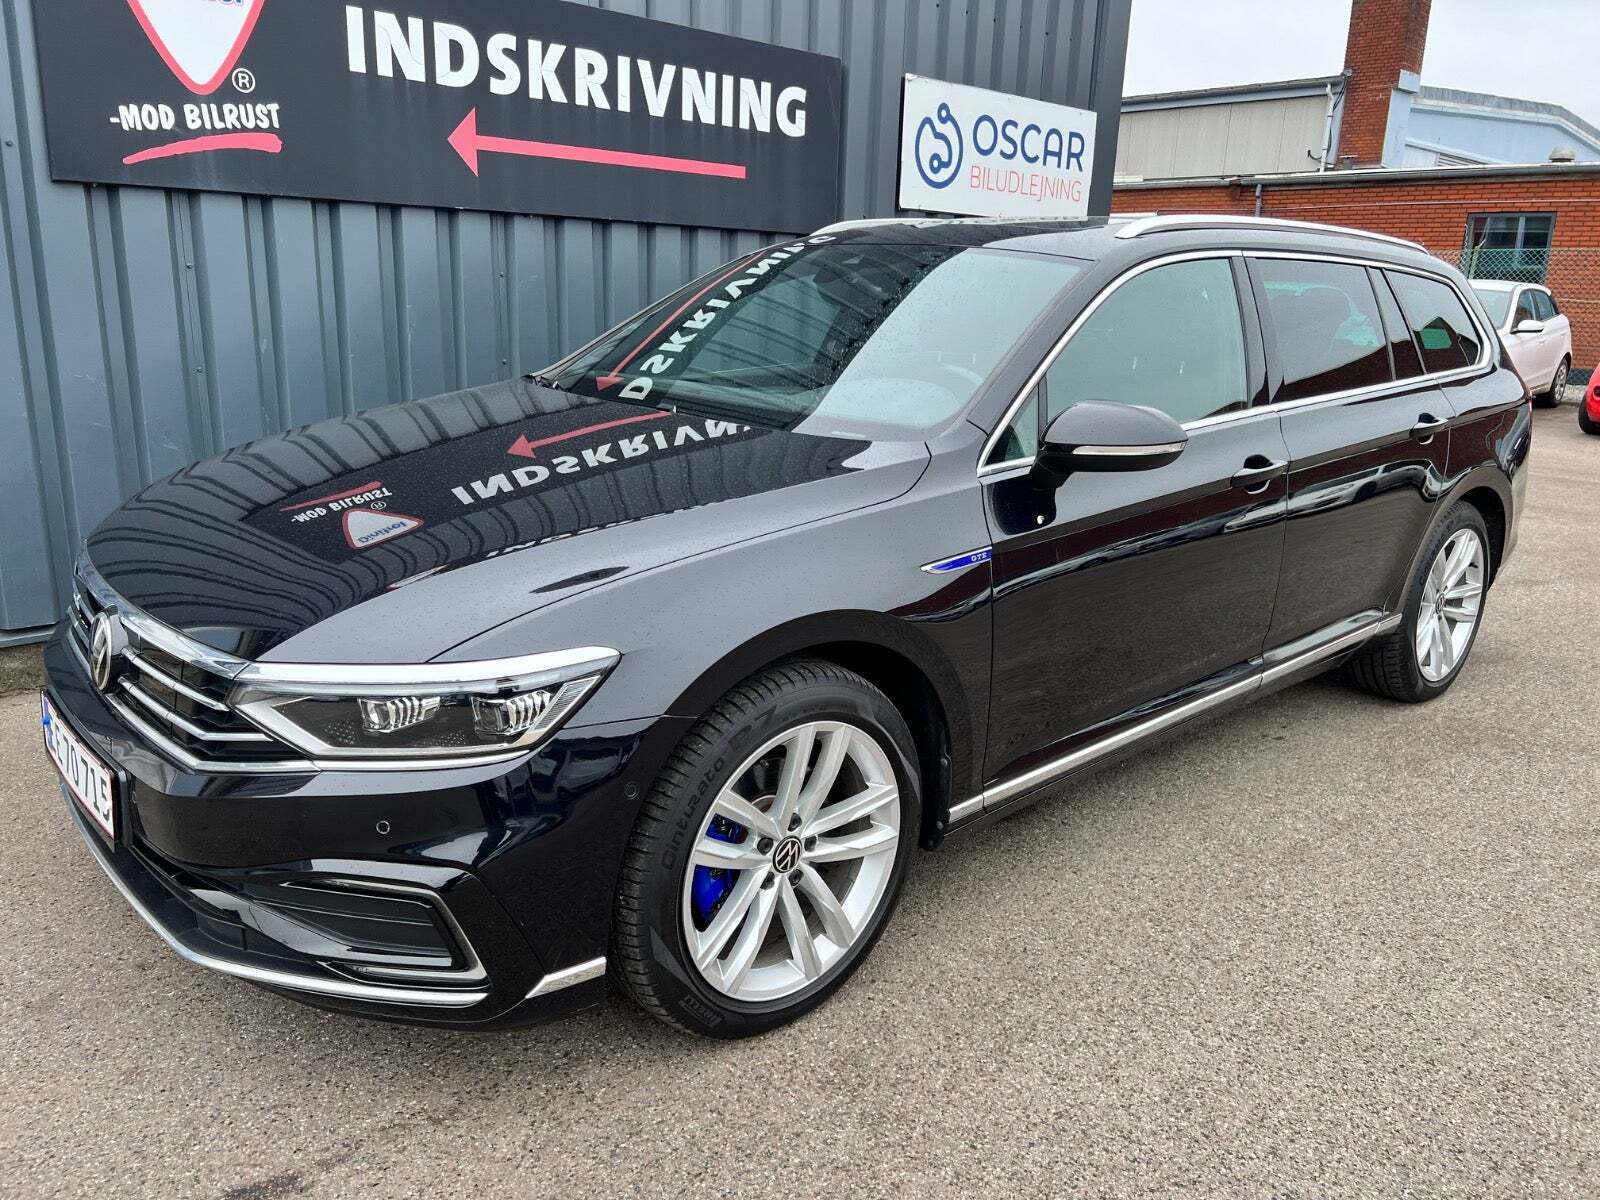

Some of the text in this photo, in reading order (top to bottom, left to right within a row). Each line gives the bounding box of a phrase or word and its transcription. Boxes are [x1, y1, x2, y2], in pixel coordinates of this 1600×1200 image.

[345, 5, 807, 138] INDSKRIVNING
[184, 102, 280, 131] BILRUST
[972, 114, 1085, 172] OSCAR
[970, 165, 1082, 202] BILUDLEJNING
